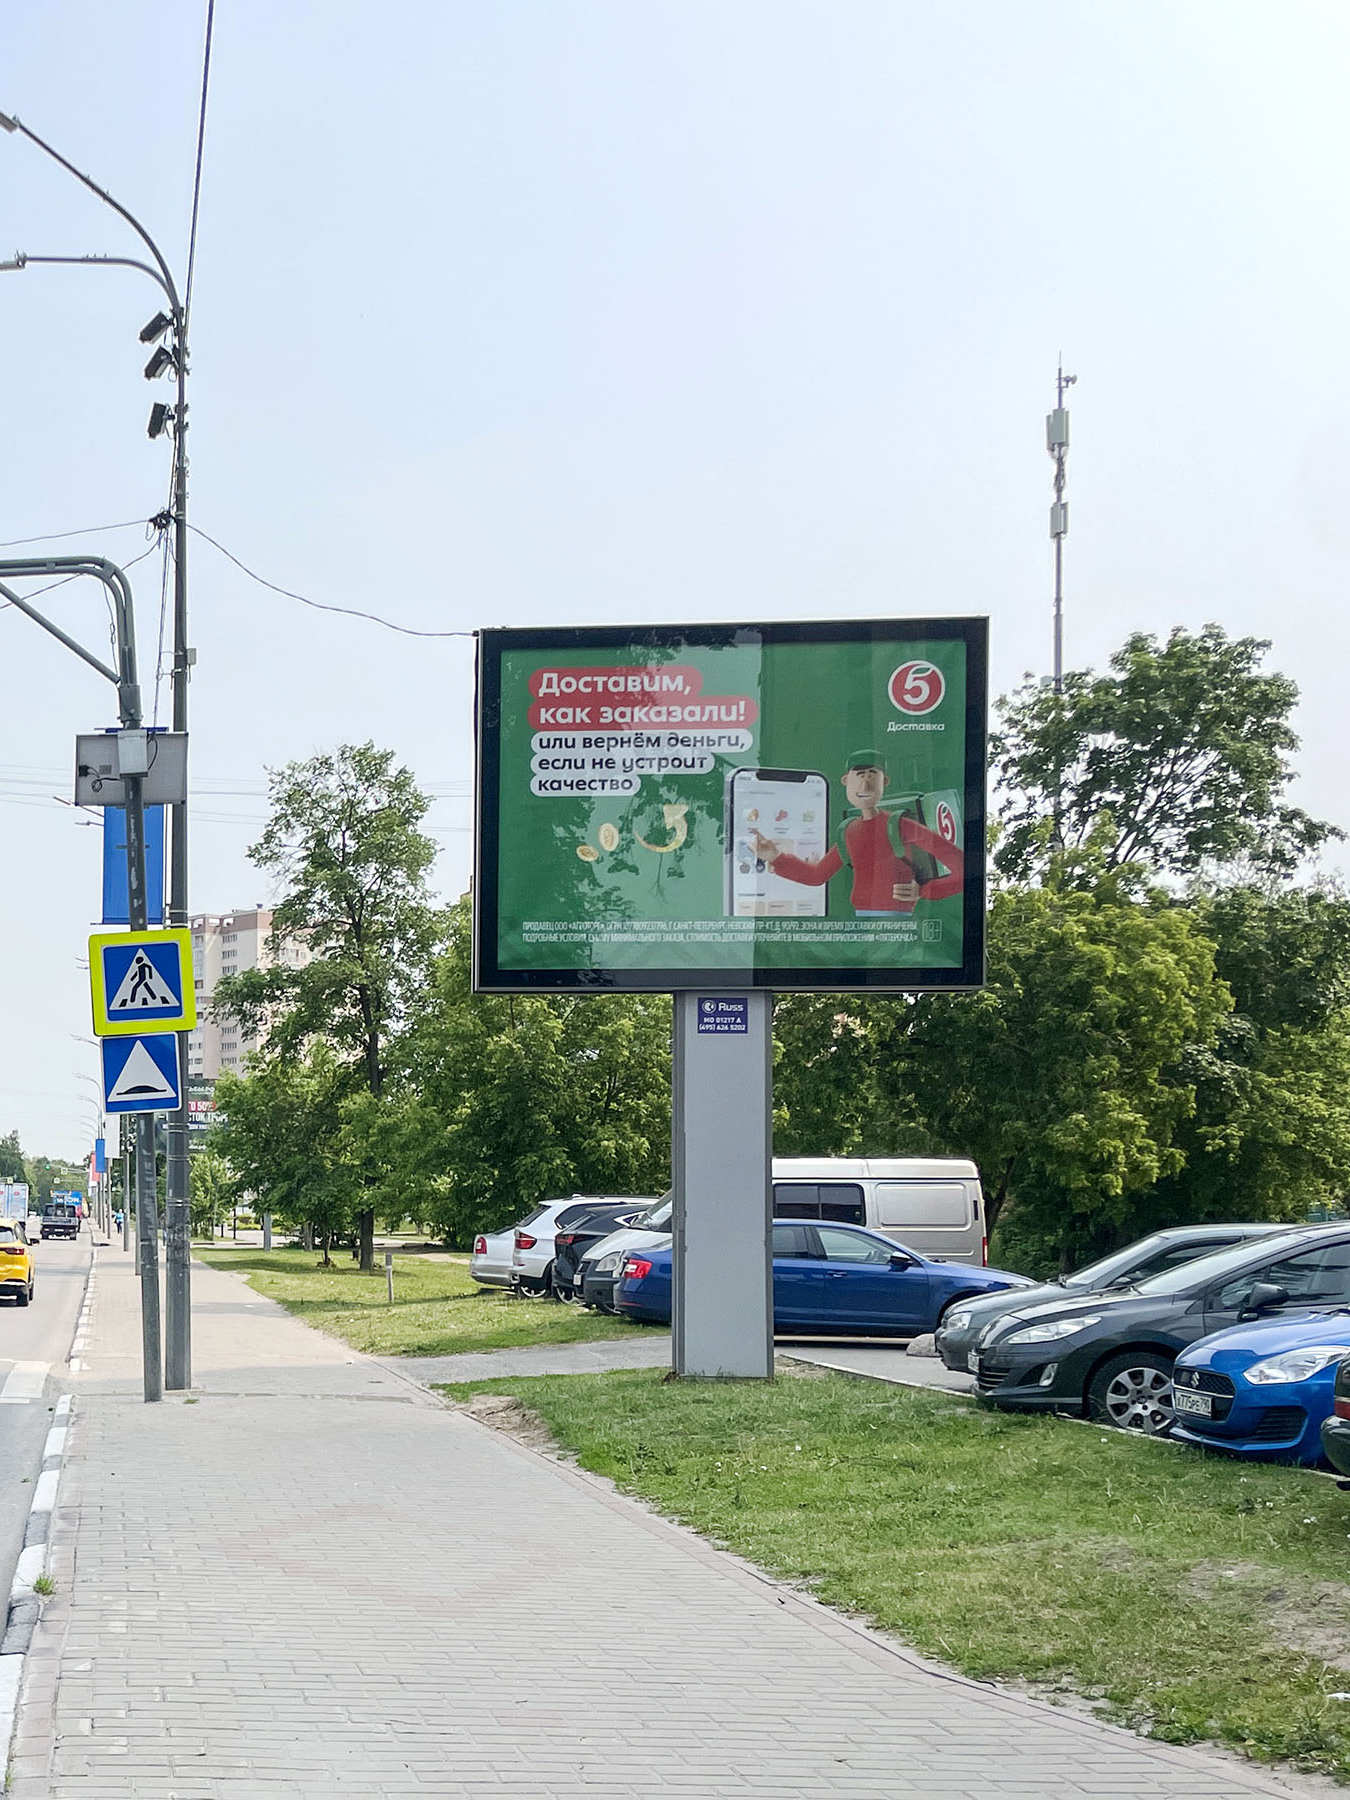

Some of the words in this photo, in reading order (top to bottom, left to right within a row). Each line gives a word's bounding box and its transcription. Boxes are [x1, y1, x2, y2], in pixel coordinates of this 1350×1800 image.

[538, 672, 691, 697] Доставим,
[539, 706, 592, 724] как
[599, 700, 747, 724] заказали!
[886, 721, 945, 733] Доставка
[538, 735, 576, 749] или
[582, 732, 661, 752] вернём
[666, 732, 746, 750] деньги,
[538, 756, 586, 770] если
[591, 757, 617, 768] не
[622, 756, 708, 773] устроит
[537, 777, 634, 791] качество
[718, 1002, 744, 1012] Russ
